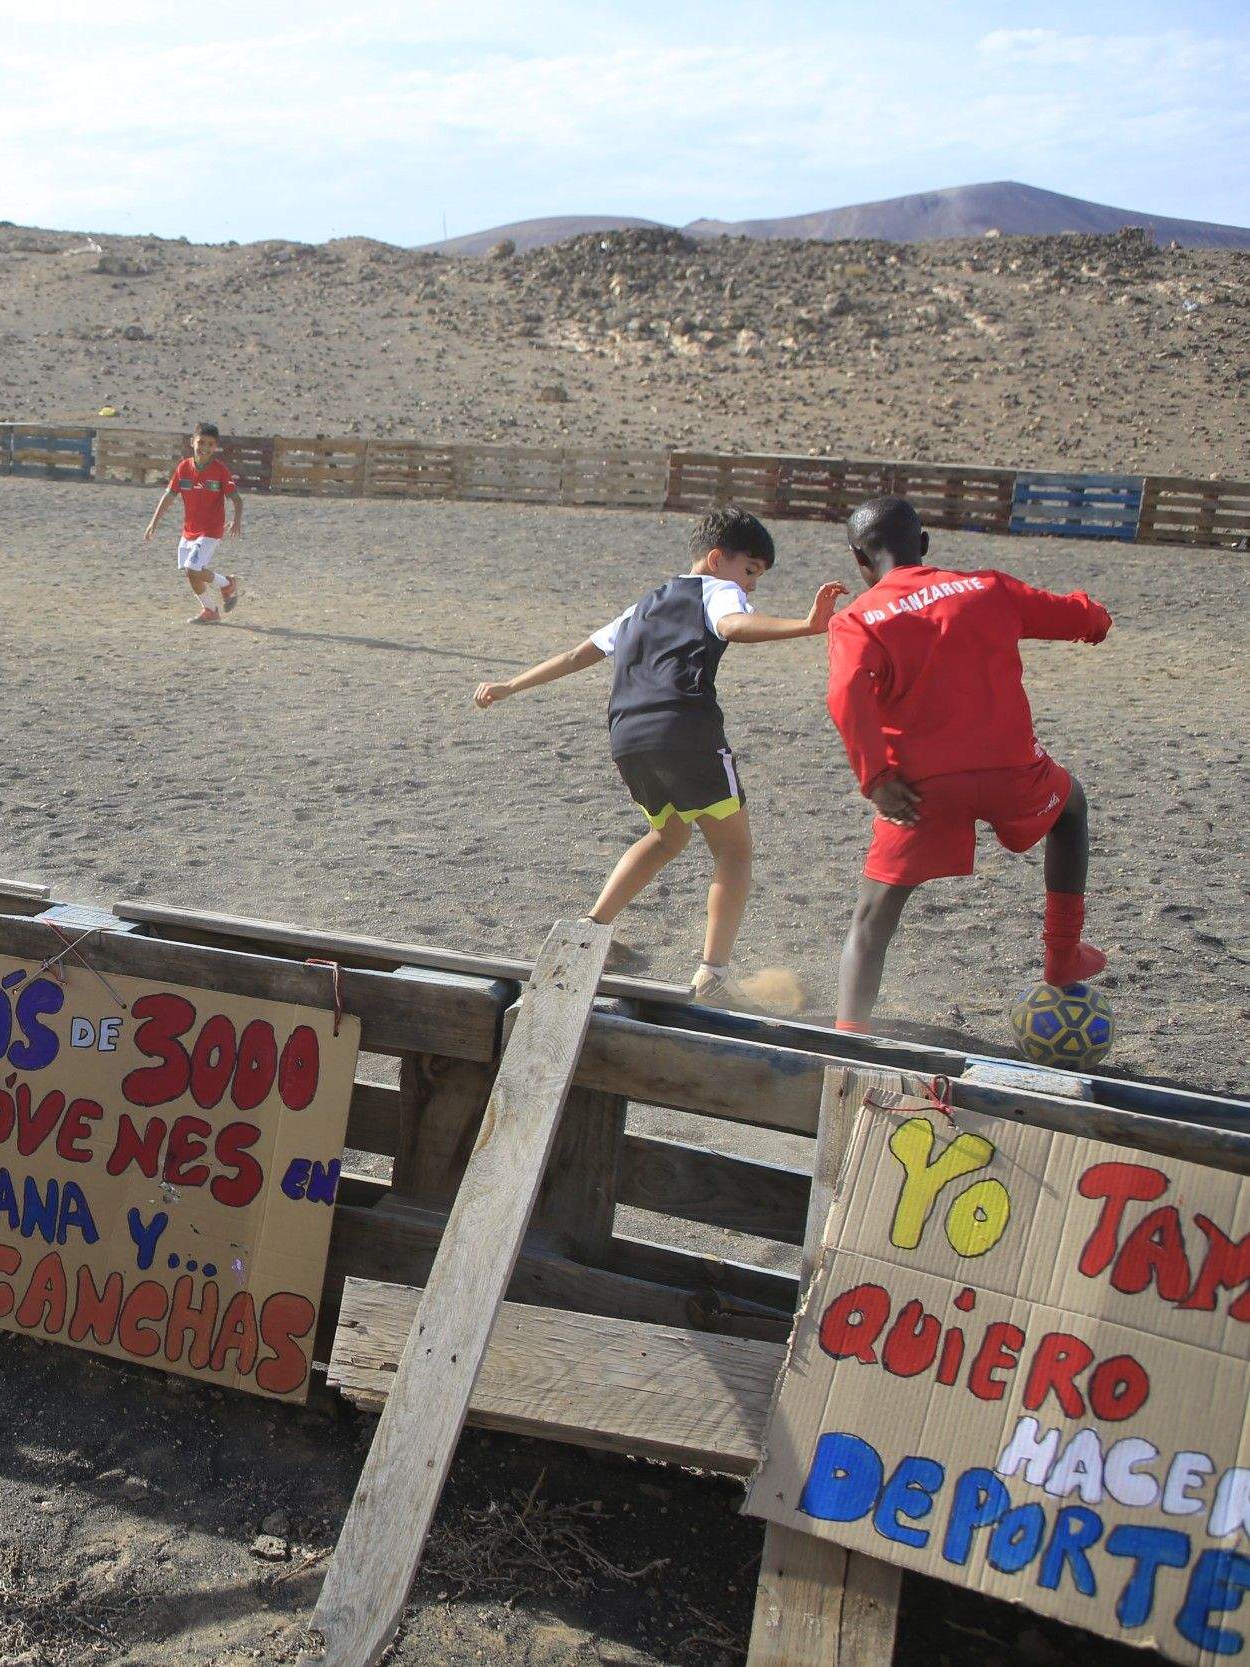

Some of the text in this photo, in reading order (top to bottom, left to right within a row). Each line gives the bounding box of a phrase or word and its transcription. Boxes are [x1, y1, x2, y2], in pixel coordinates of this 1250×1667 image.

[886, 576, 985, 616] LANZAROTE
[69, 1015, 124, 1052] DE
[121, 992, 321, 1110] 3000
[280, 1157, 342, 1205] EN
[127, 1207, 218, 1278] Y...
[798, 1431, 1250, 1656] DEPORTE
